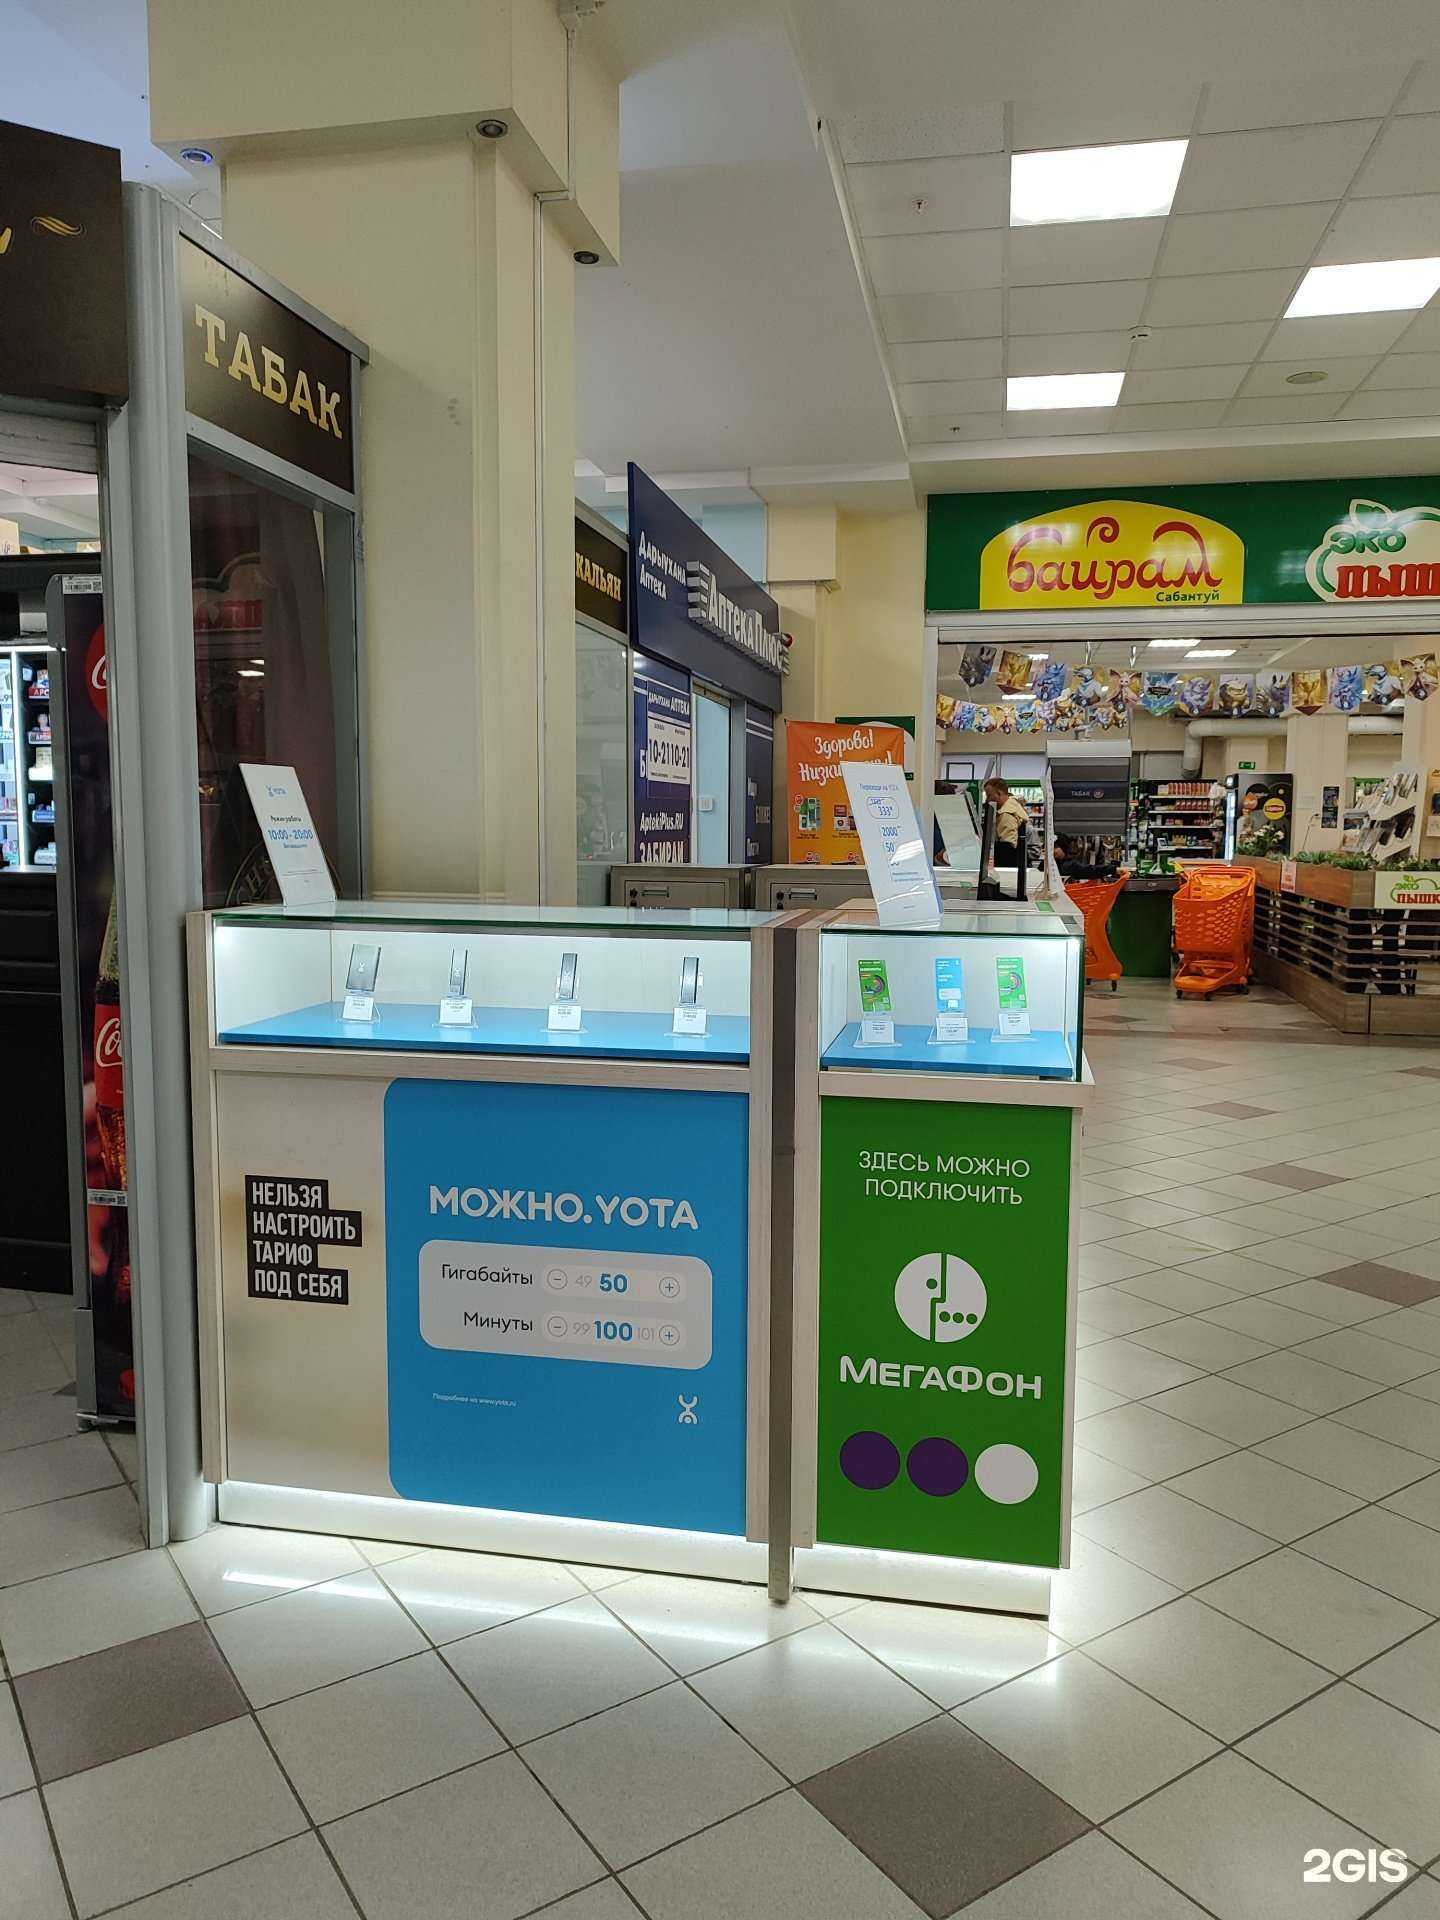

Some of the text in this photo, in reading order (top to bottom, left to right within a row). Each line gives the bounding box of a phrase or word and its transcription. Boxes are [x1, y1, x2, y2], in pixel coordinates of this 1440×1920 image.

[195, 304, 342, 439] ТАБАК
[575, 551, 622, 602] КАЛЬЯН
[1156, 590, 1219, 603] Сабантуй
[670, 696, 690, 716] АПТЕКА
[814, 728, 873, 759] Здорово!
[798, 762, 842, 786] Низки
[268, 829, 288, 840] 10:00
[293, 829, 314, 840] 20:00
[859, 1151, 1031, 1178] ЗДЕСЬ МОЖНО
[252, 1181, 322, 1209] НЕЛЬЗЯ
[865, 1178, 1023, 1205] ПОДКЛЮЧИТЬ
[429, 1184, 699, 1230] МОЖНО.YOTA
[253, 1211, 356, 1240] НАСТРОИТЬ
[253, 1240, 313, 1266] ТАРИФ
[254, 1269, 342, 1299] ПОД СЕБЯ
[441, 1264, 628, 1293] Гигабайты 49 50
[463, 1312, 533, 1334] Минуты
[573, 1322, 591, 1336] 99
[594, 1321, 633, 1342] 100
